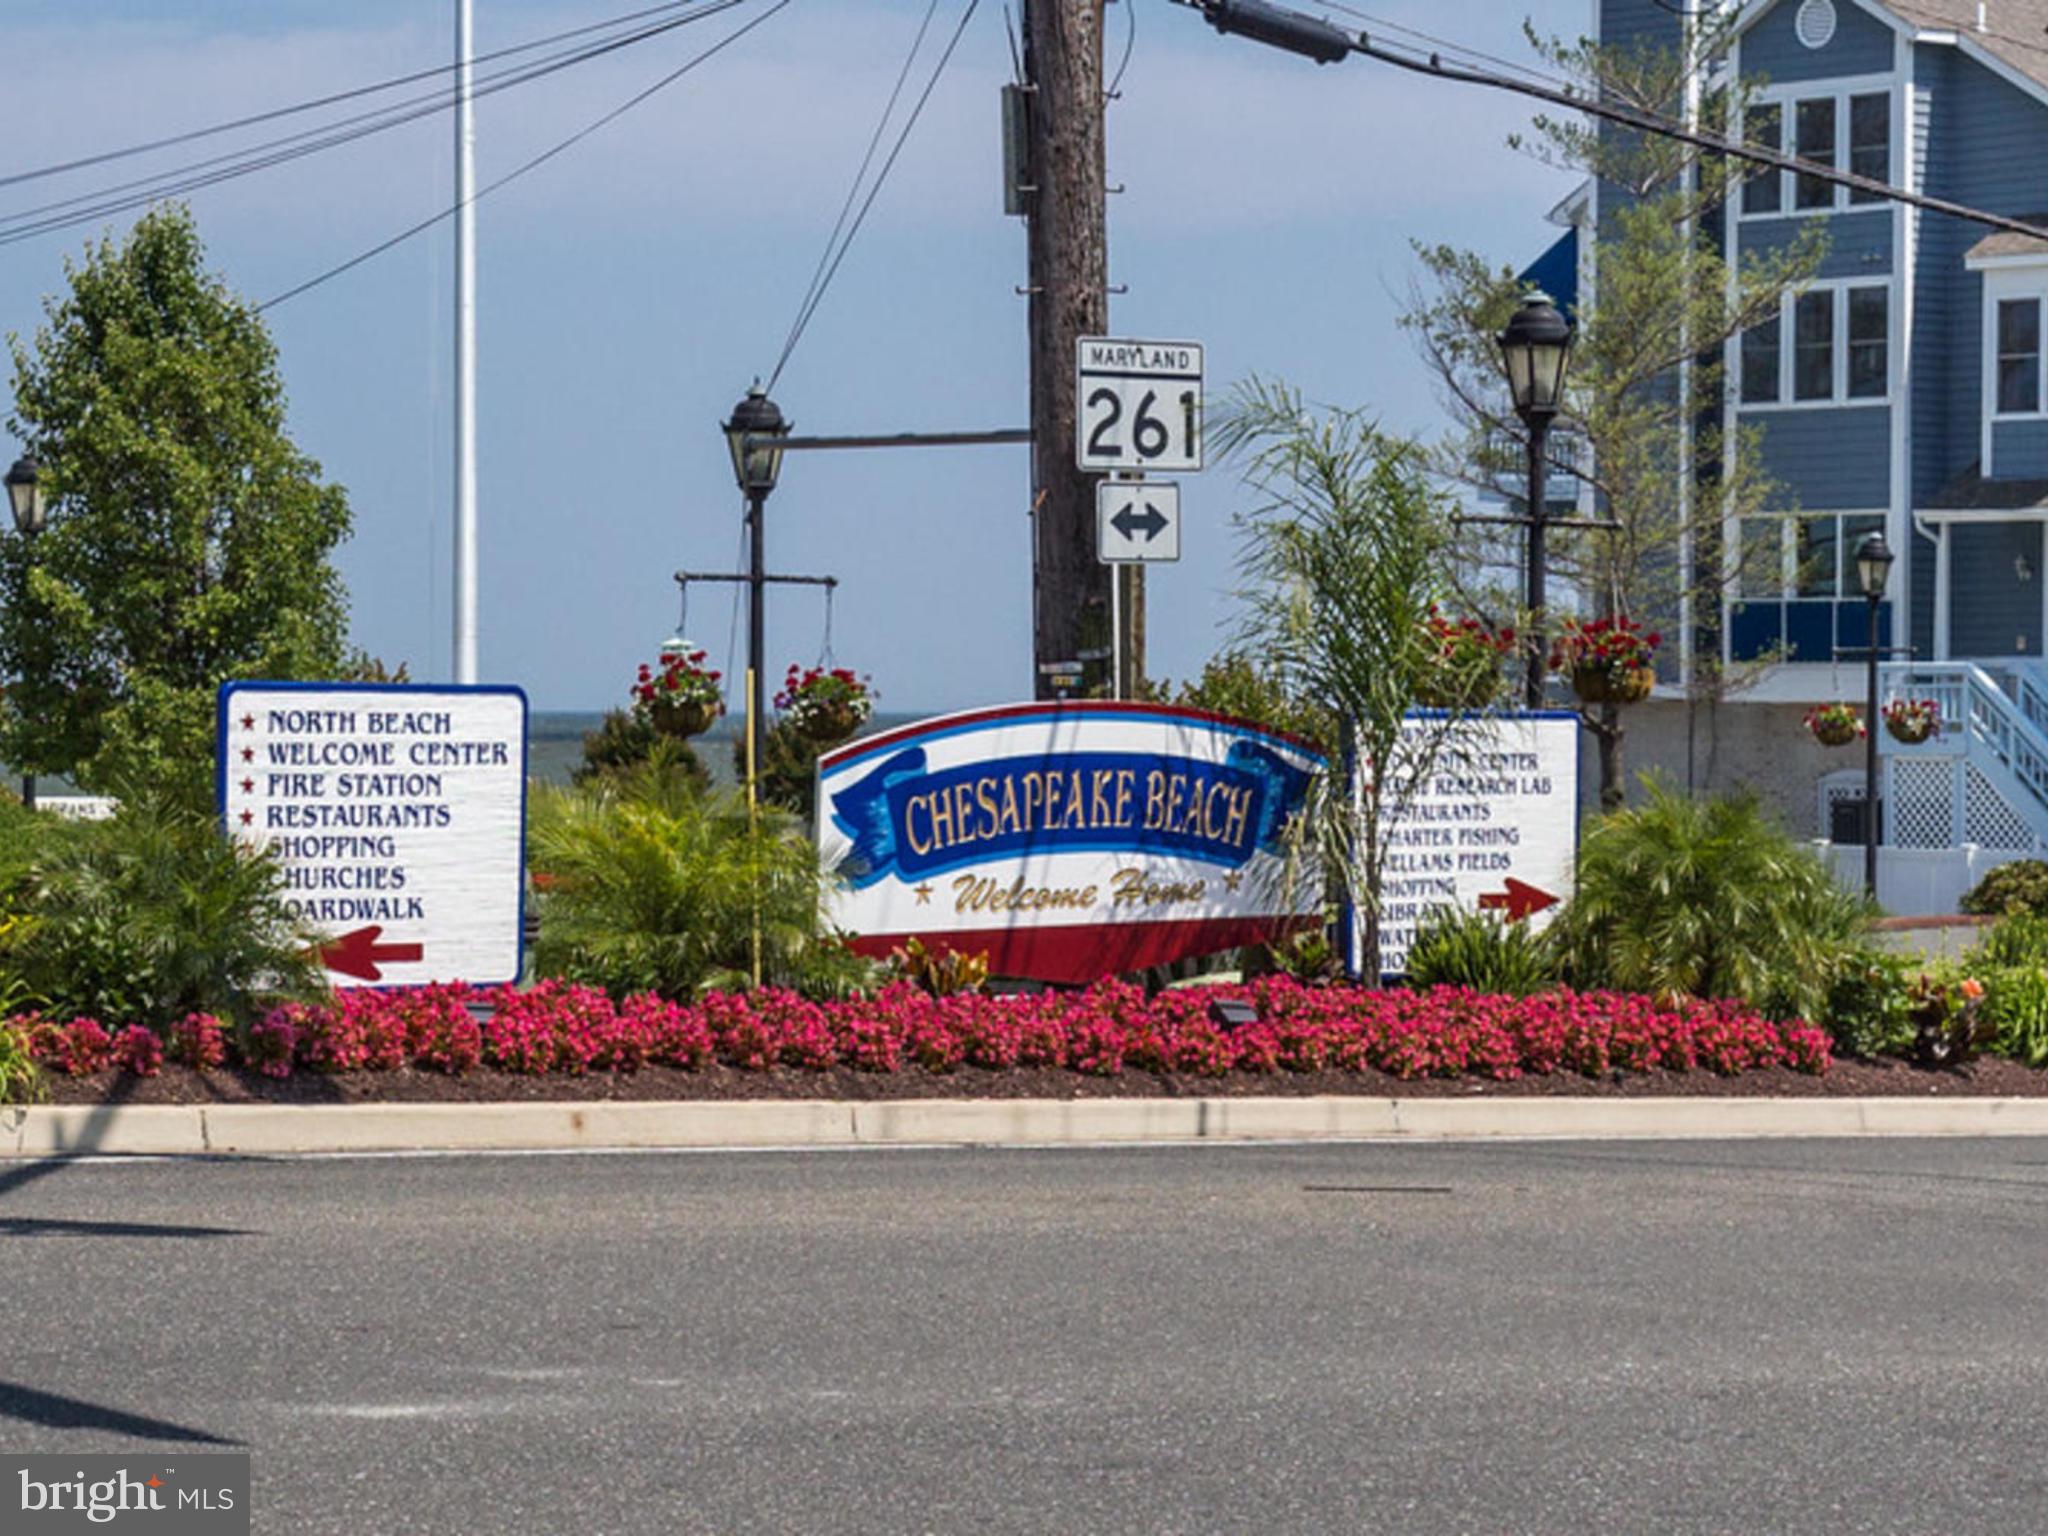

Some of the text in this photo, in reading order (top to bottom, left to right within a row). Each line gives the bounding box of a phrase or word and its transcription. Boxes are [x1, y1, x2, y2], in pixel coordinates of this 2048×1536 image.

[1091, 347, 1190, 370] MARYLAND
[1087, 387, 1195, 459] 261
[267, 710, 451, 735] NORTH BEACH
[267, 742, 509, 766] WELCOME CENTER
[267, 773, 443, 797] FIRE STATION
[1521, 778, 1552, 795] LAB
[267, 804, 451, 828] RESTAURANTS
[905, 769, 1254, 856] CHESAPEAKE BEACH
[1458, 828, 1520, 846] FISHING
[1457, 853, 1512, 871] FIELDS
[284, 866, 406, 890] HURCHES
[951, 868, 1207, 914] Welcome Home
[277, 897, 425, 921] OARDWALK
